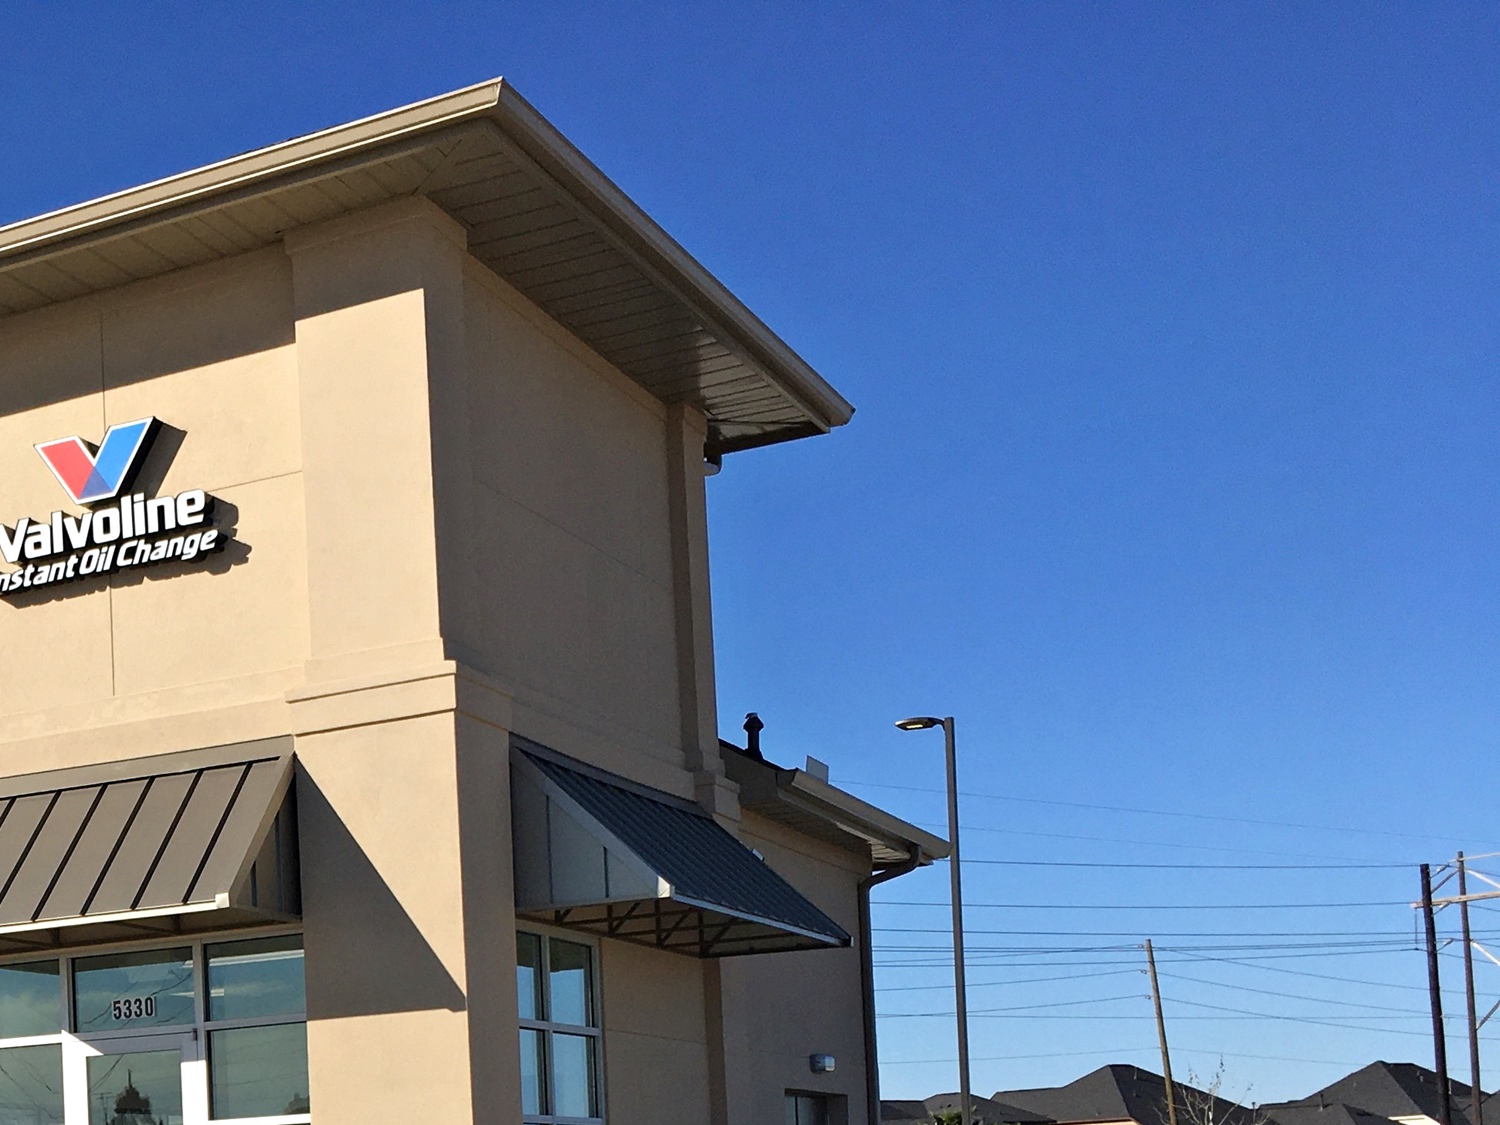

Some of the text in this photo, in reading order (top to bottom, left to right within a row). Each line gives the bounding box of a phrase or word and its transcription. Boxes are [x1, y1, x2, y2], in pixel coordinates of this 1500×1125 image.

[78, 543, 116, 575] Oil
[116, 529, 219, 567] Change
[113, 997, 154, 1020] 5330
